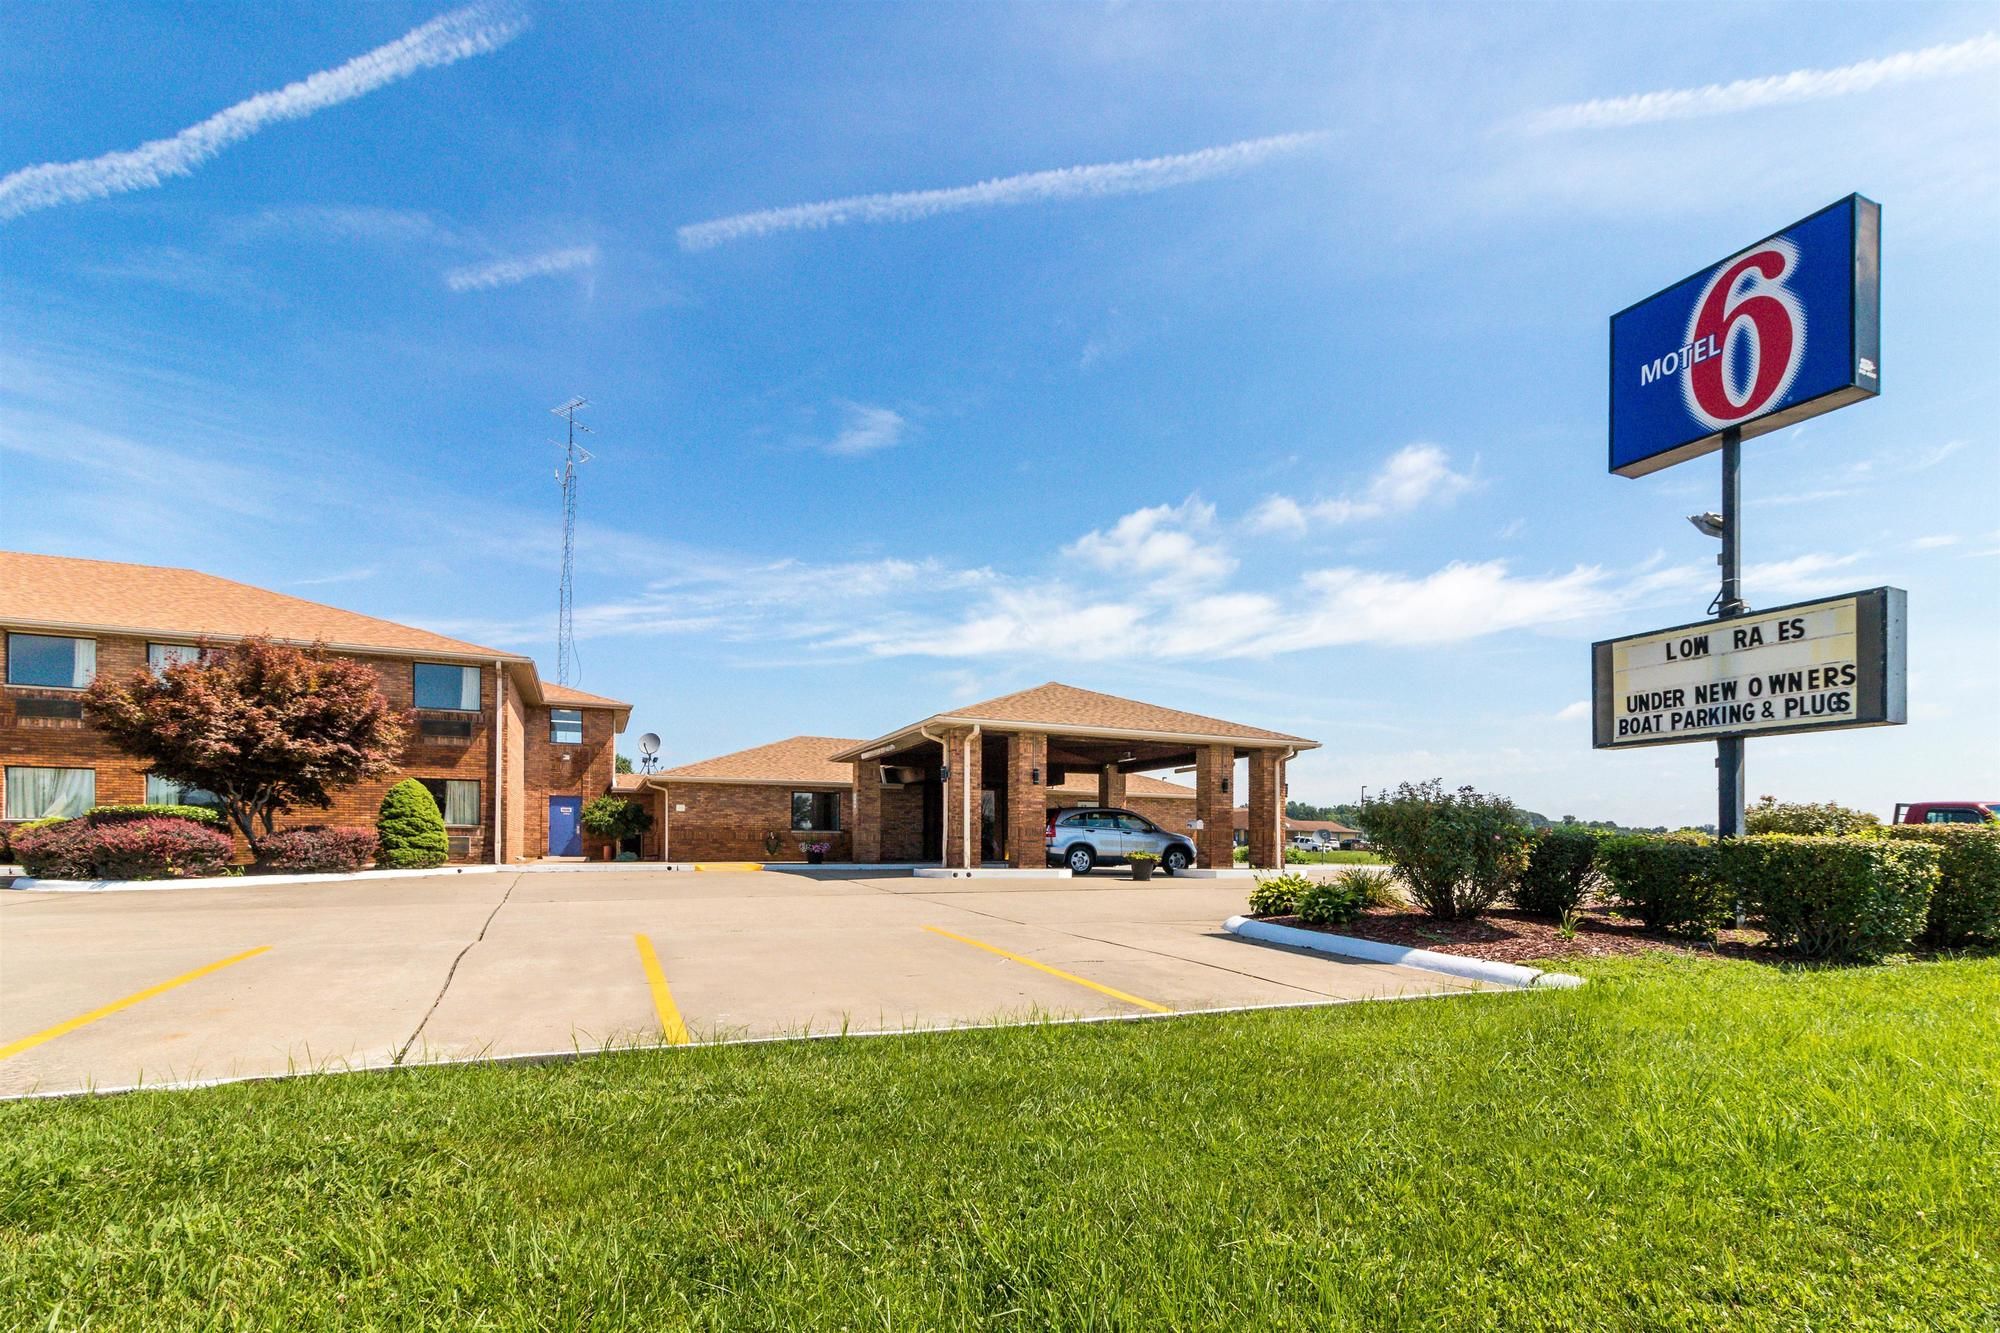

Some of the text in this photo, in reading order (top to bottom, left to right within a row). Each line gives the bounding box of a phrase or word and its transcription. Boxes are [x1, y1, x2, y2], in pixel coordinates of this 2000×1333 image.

[1640, 250, 1793, 421] MOTEL 6
[1666, 635, 1709, 661] LOW
[1626, 664, 1856, 713] UNDER NEW OWNERS
[1619, 691, 1851, 736] BOAT PARKING & PLUGS
